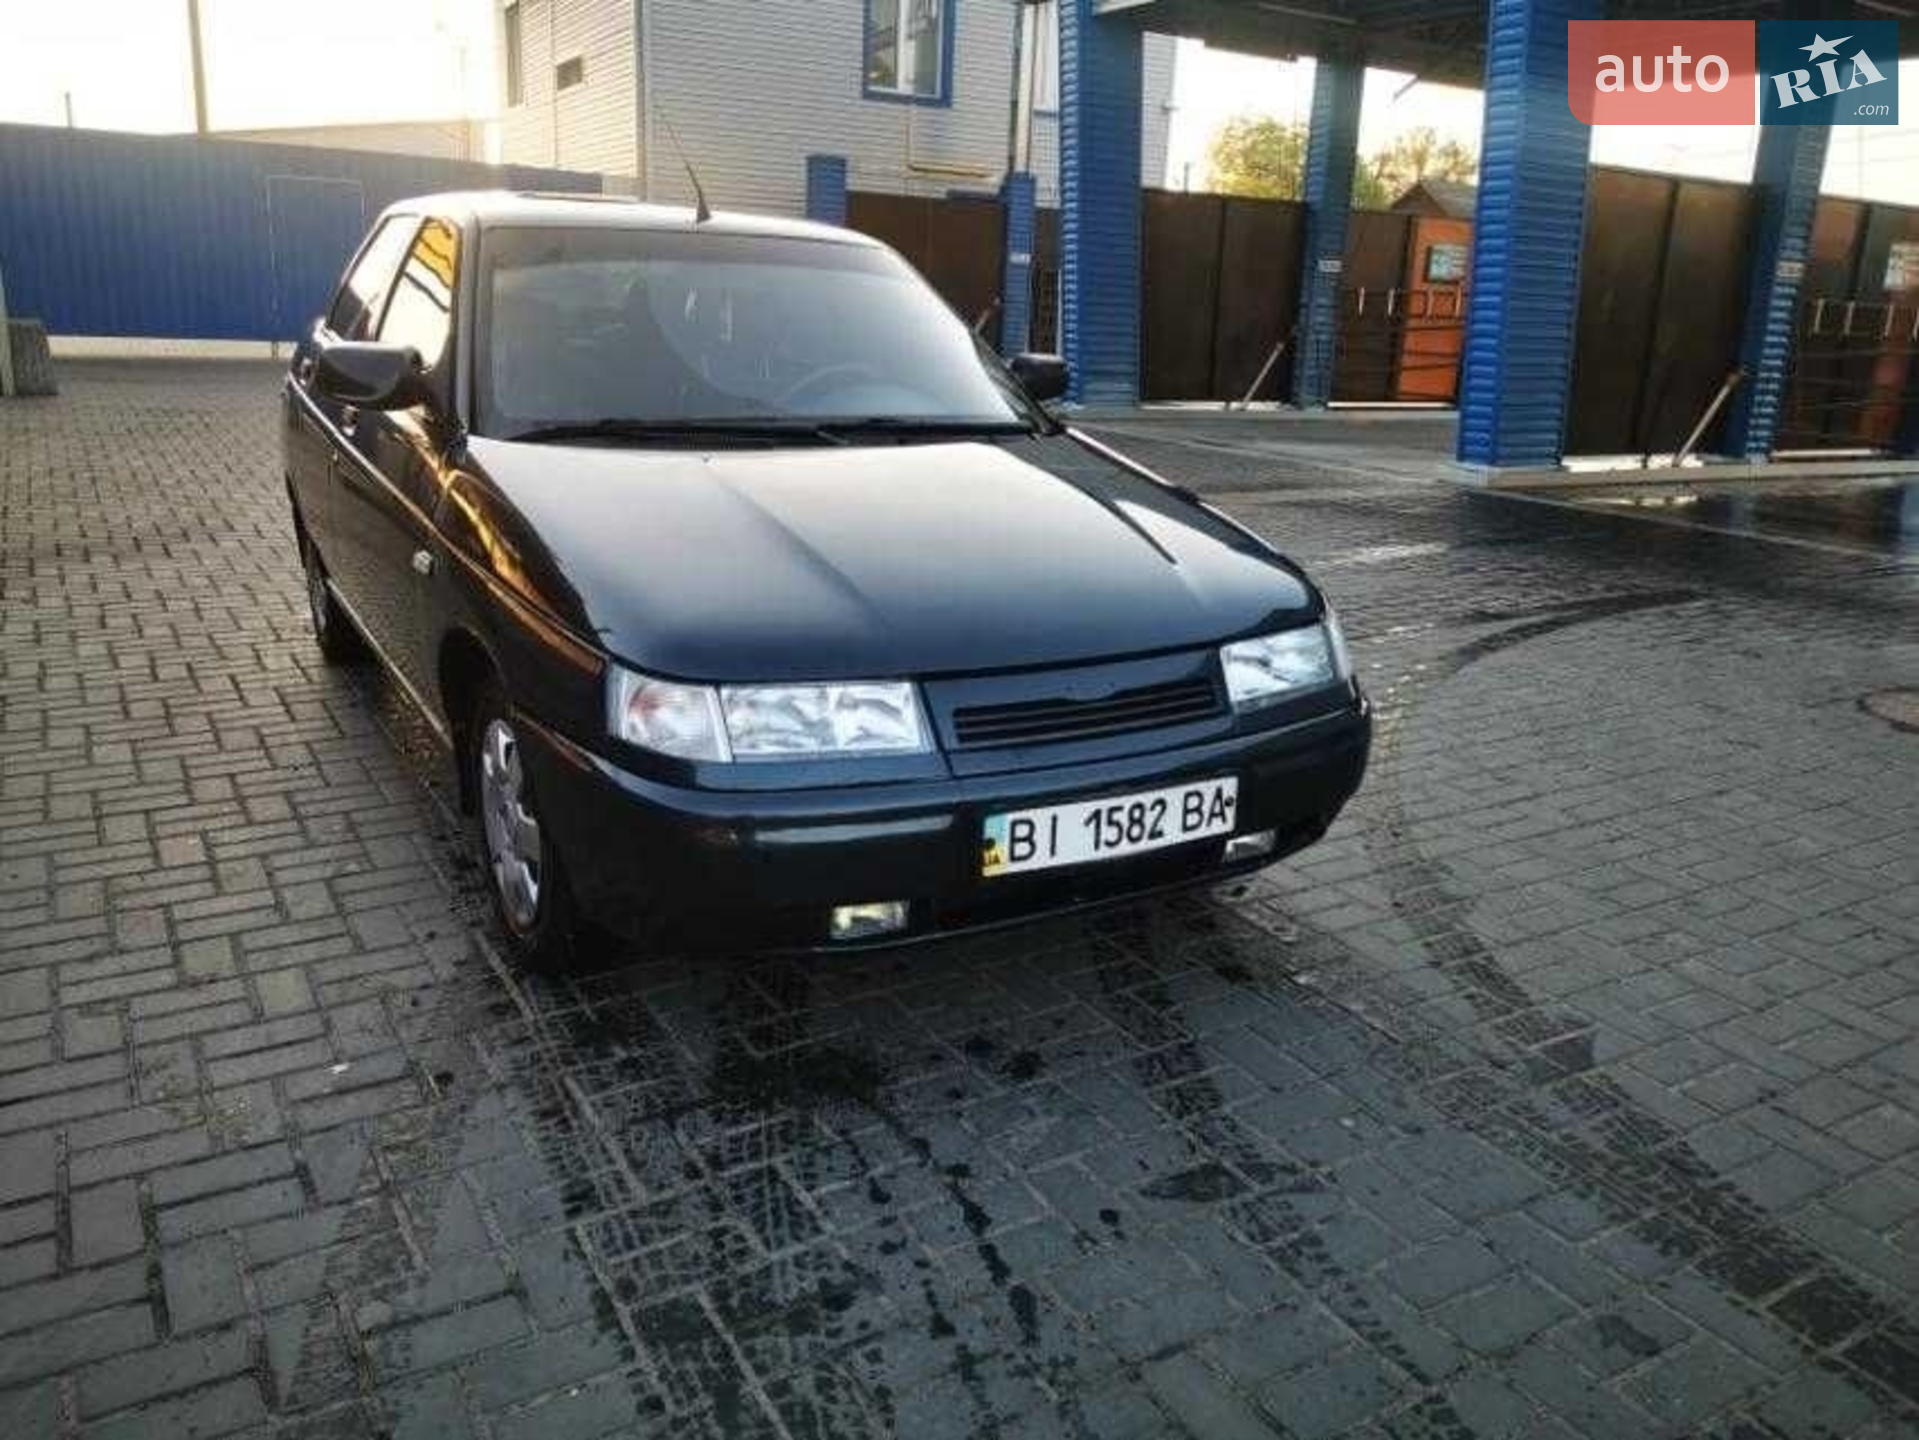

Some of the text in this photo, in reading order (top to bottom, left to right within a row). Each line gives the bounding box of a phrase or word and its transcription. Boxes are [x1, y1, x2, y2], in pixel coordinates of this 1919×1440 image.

[1009, 787, 1228, 863] BI 1582 BA
